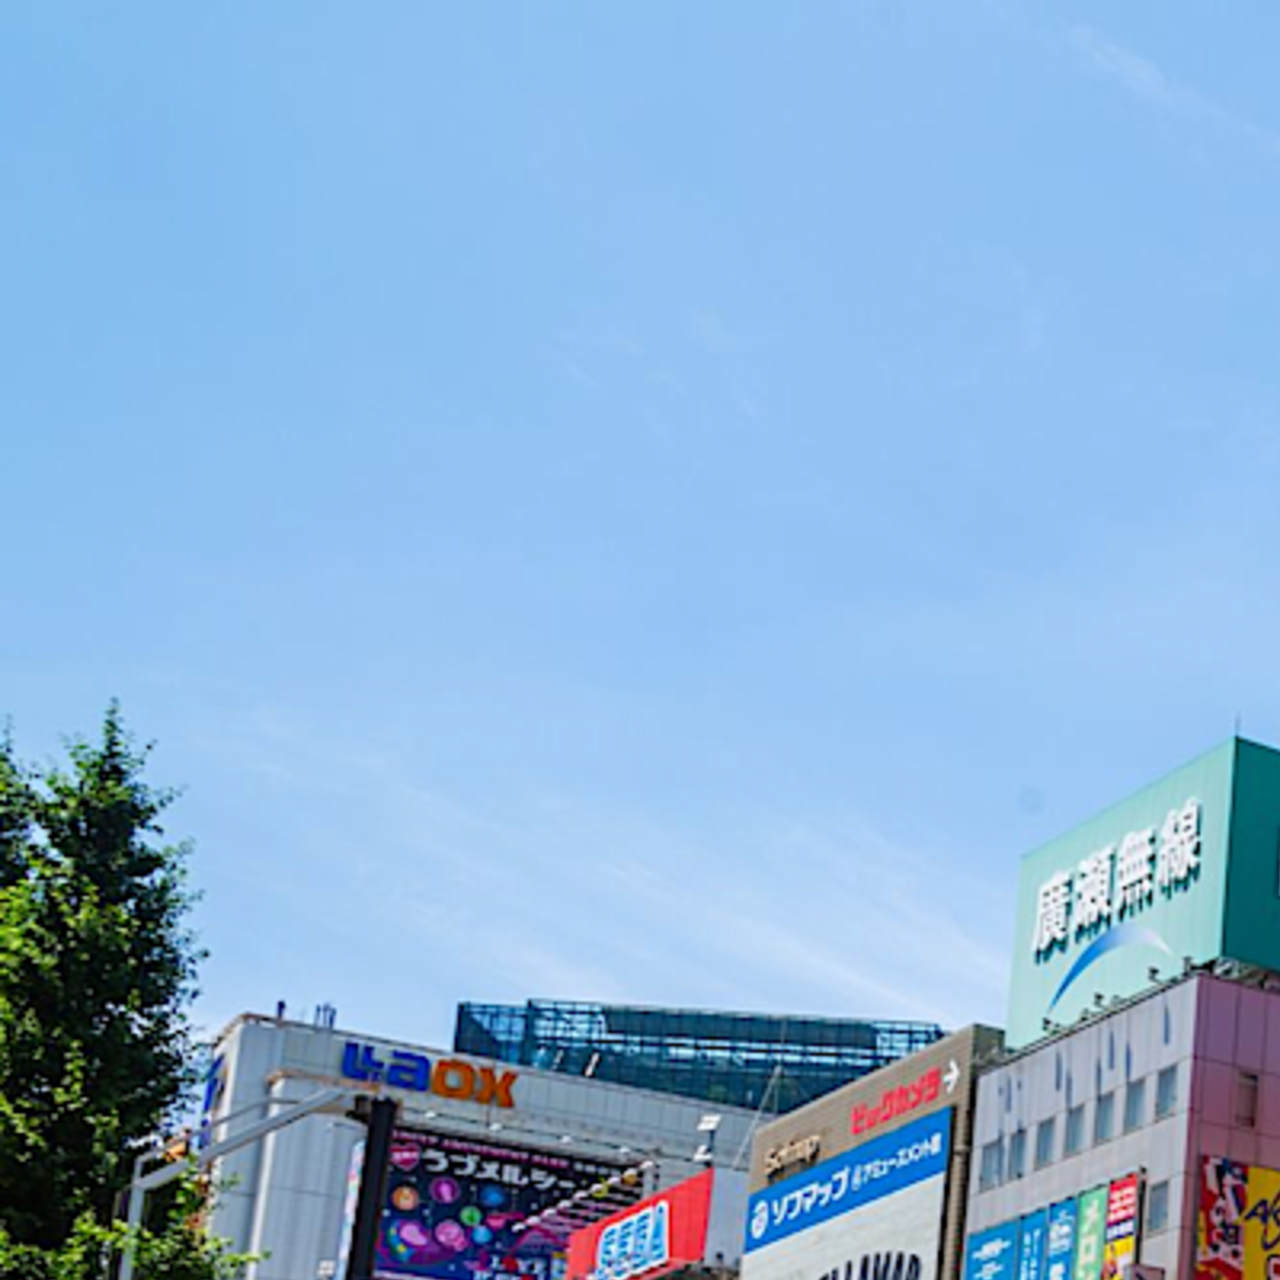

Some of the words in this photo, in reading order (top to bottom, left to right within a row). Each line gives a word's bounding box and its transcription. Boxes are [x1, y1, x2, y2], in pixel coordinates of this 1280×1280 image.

[773, 1165, 850, 1226] ソフマップ
